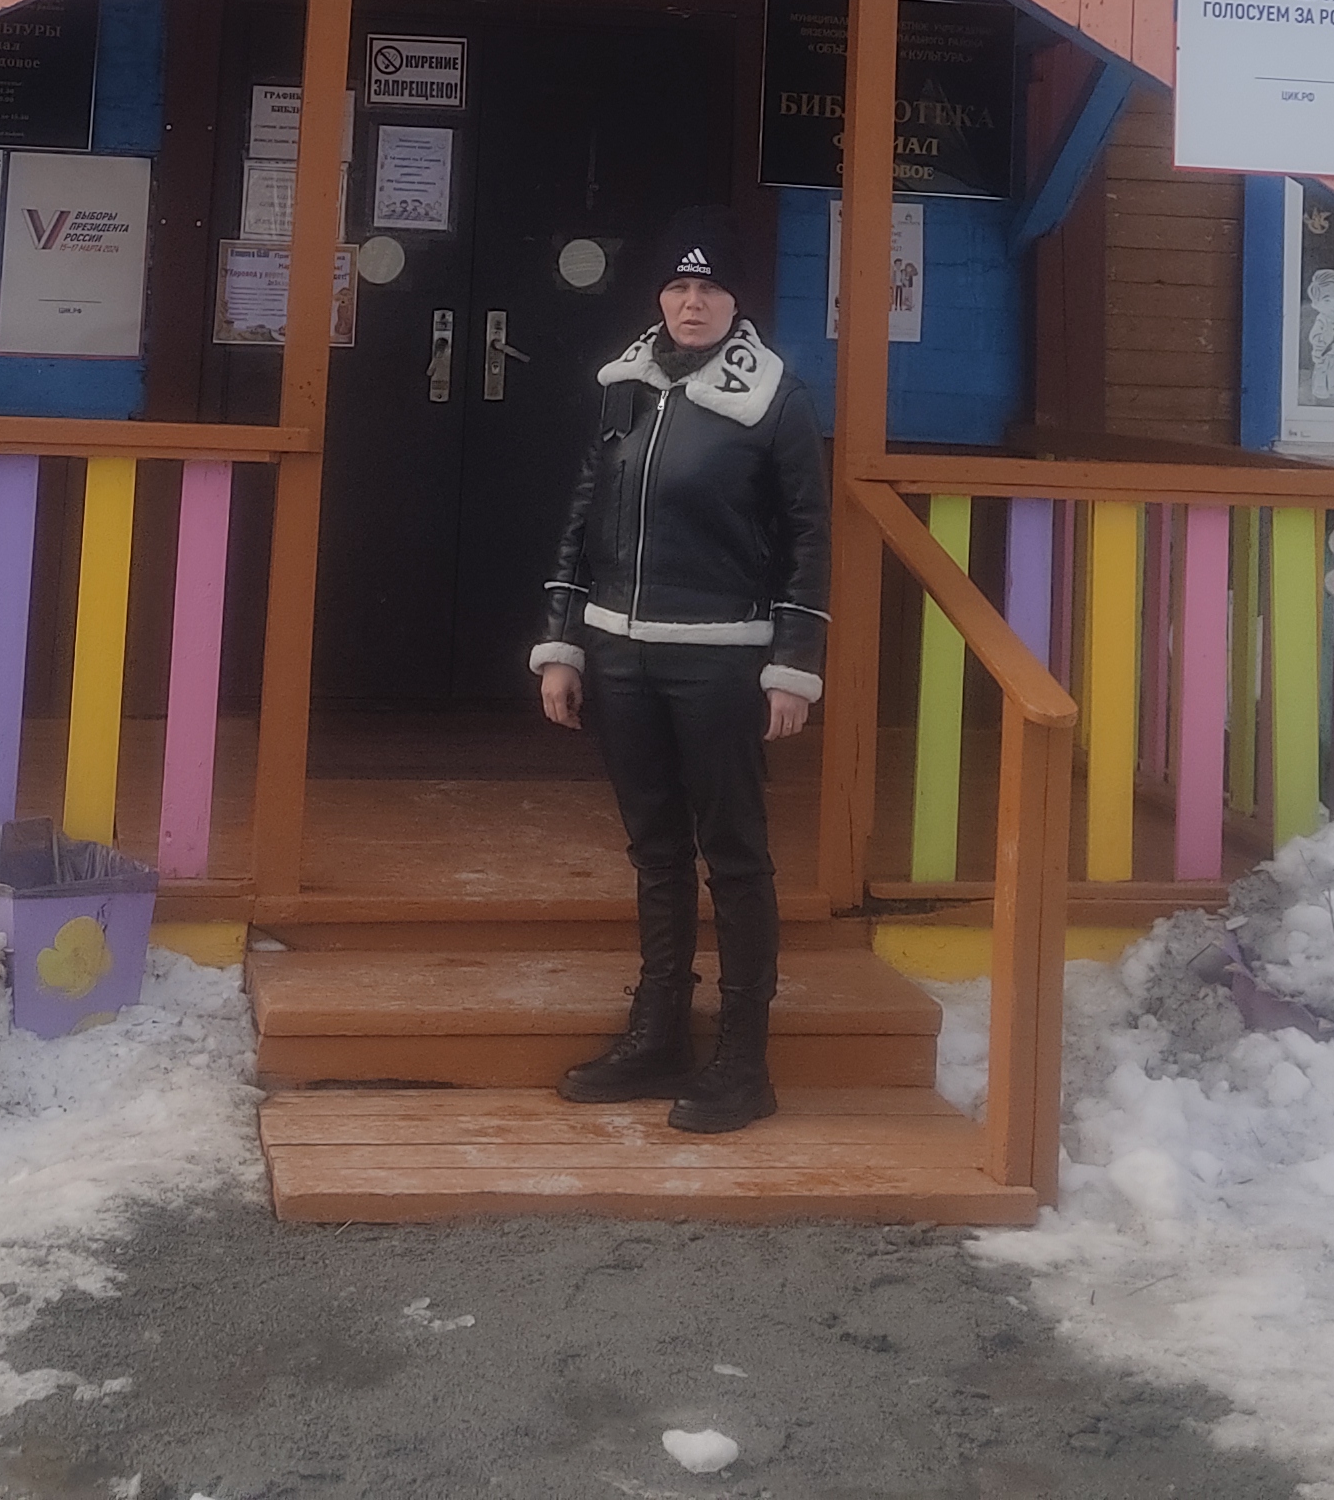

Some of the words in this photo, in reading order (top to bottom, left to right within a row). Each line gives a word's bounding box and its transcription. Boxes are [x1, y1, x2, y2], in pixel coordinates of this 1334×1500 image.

[1203, 1, 1290, 22] ГОЛОСУЕМ
[1294, 7, 1315, 24] ЗА
[405, 54, 459, 70] КУРЕНИЕ
[374, 79, 458, 100] ЗАПРЕЩЕНО!
[1281, 91, 1315, 103] ЦИК.РФ
[780, 92, 994, 128] БИБОТЕКА
[74, 211, 118, 221] ВЫБОРЫ
[69, 222, 130, 233] ПРЕЗИДЕНТА
[63, 233, 103, 243] РОССИИ
[677, 263, 711, 275] adidas
